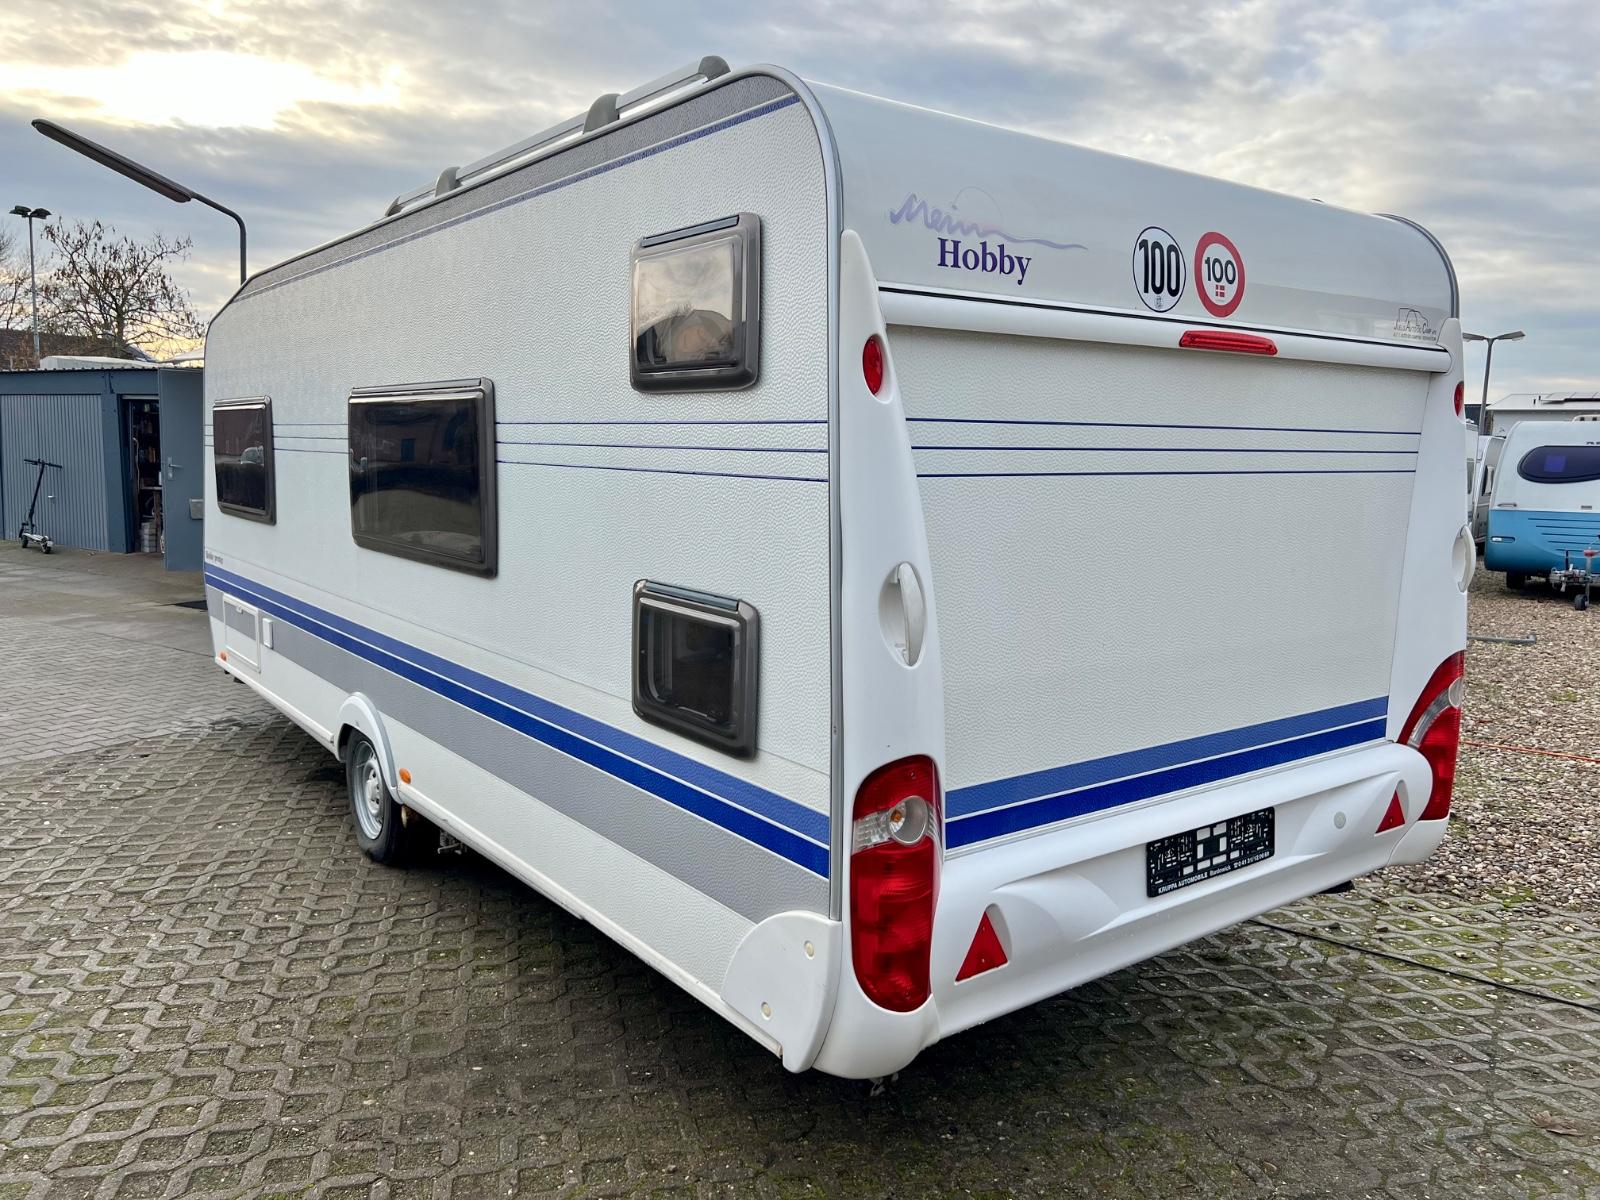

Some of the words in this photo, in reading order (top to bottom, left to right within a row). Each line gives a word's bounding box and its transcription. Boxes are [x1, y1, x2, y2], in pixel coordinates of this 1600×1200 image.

[937, 236, 1032, 286] Hobby
[1138, 238, 1181, 298] 100
[1204, 256, 1237, 285] 100
